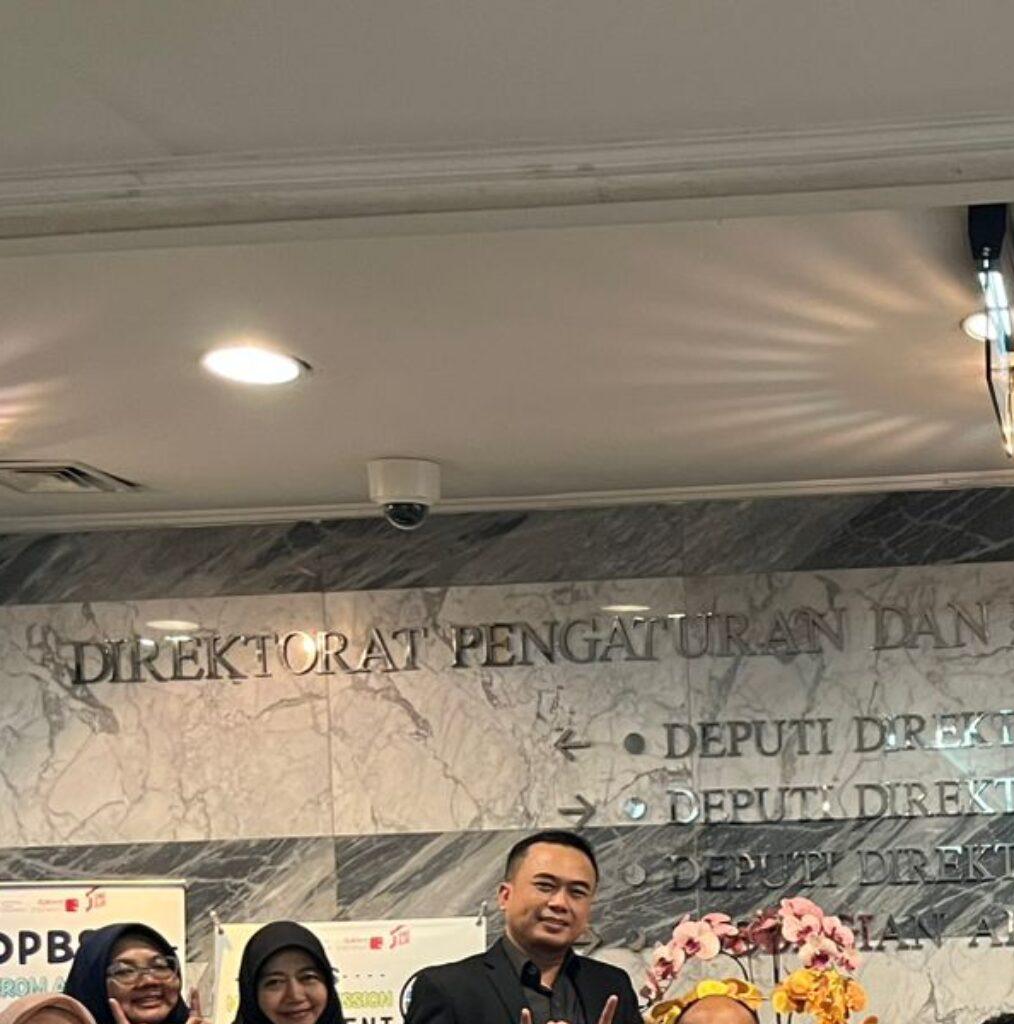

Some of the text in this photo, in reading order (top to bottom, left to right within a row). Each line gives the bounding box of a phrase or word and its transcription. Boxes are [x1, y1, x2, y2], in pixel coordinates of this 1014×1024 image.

[71, 625, 428, 686] DIREKTORAT
[451, 607, 846, 668] PENGATURAN
[870, 599, 990, 651] DAN
[663, 717, 834, 759] DEPUTI
[665, 783, 835, 826] DEPUTI
[667, 850, 838, 893] DEPUTI
[839, 912, 947, 952] IAN
